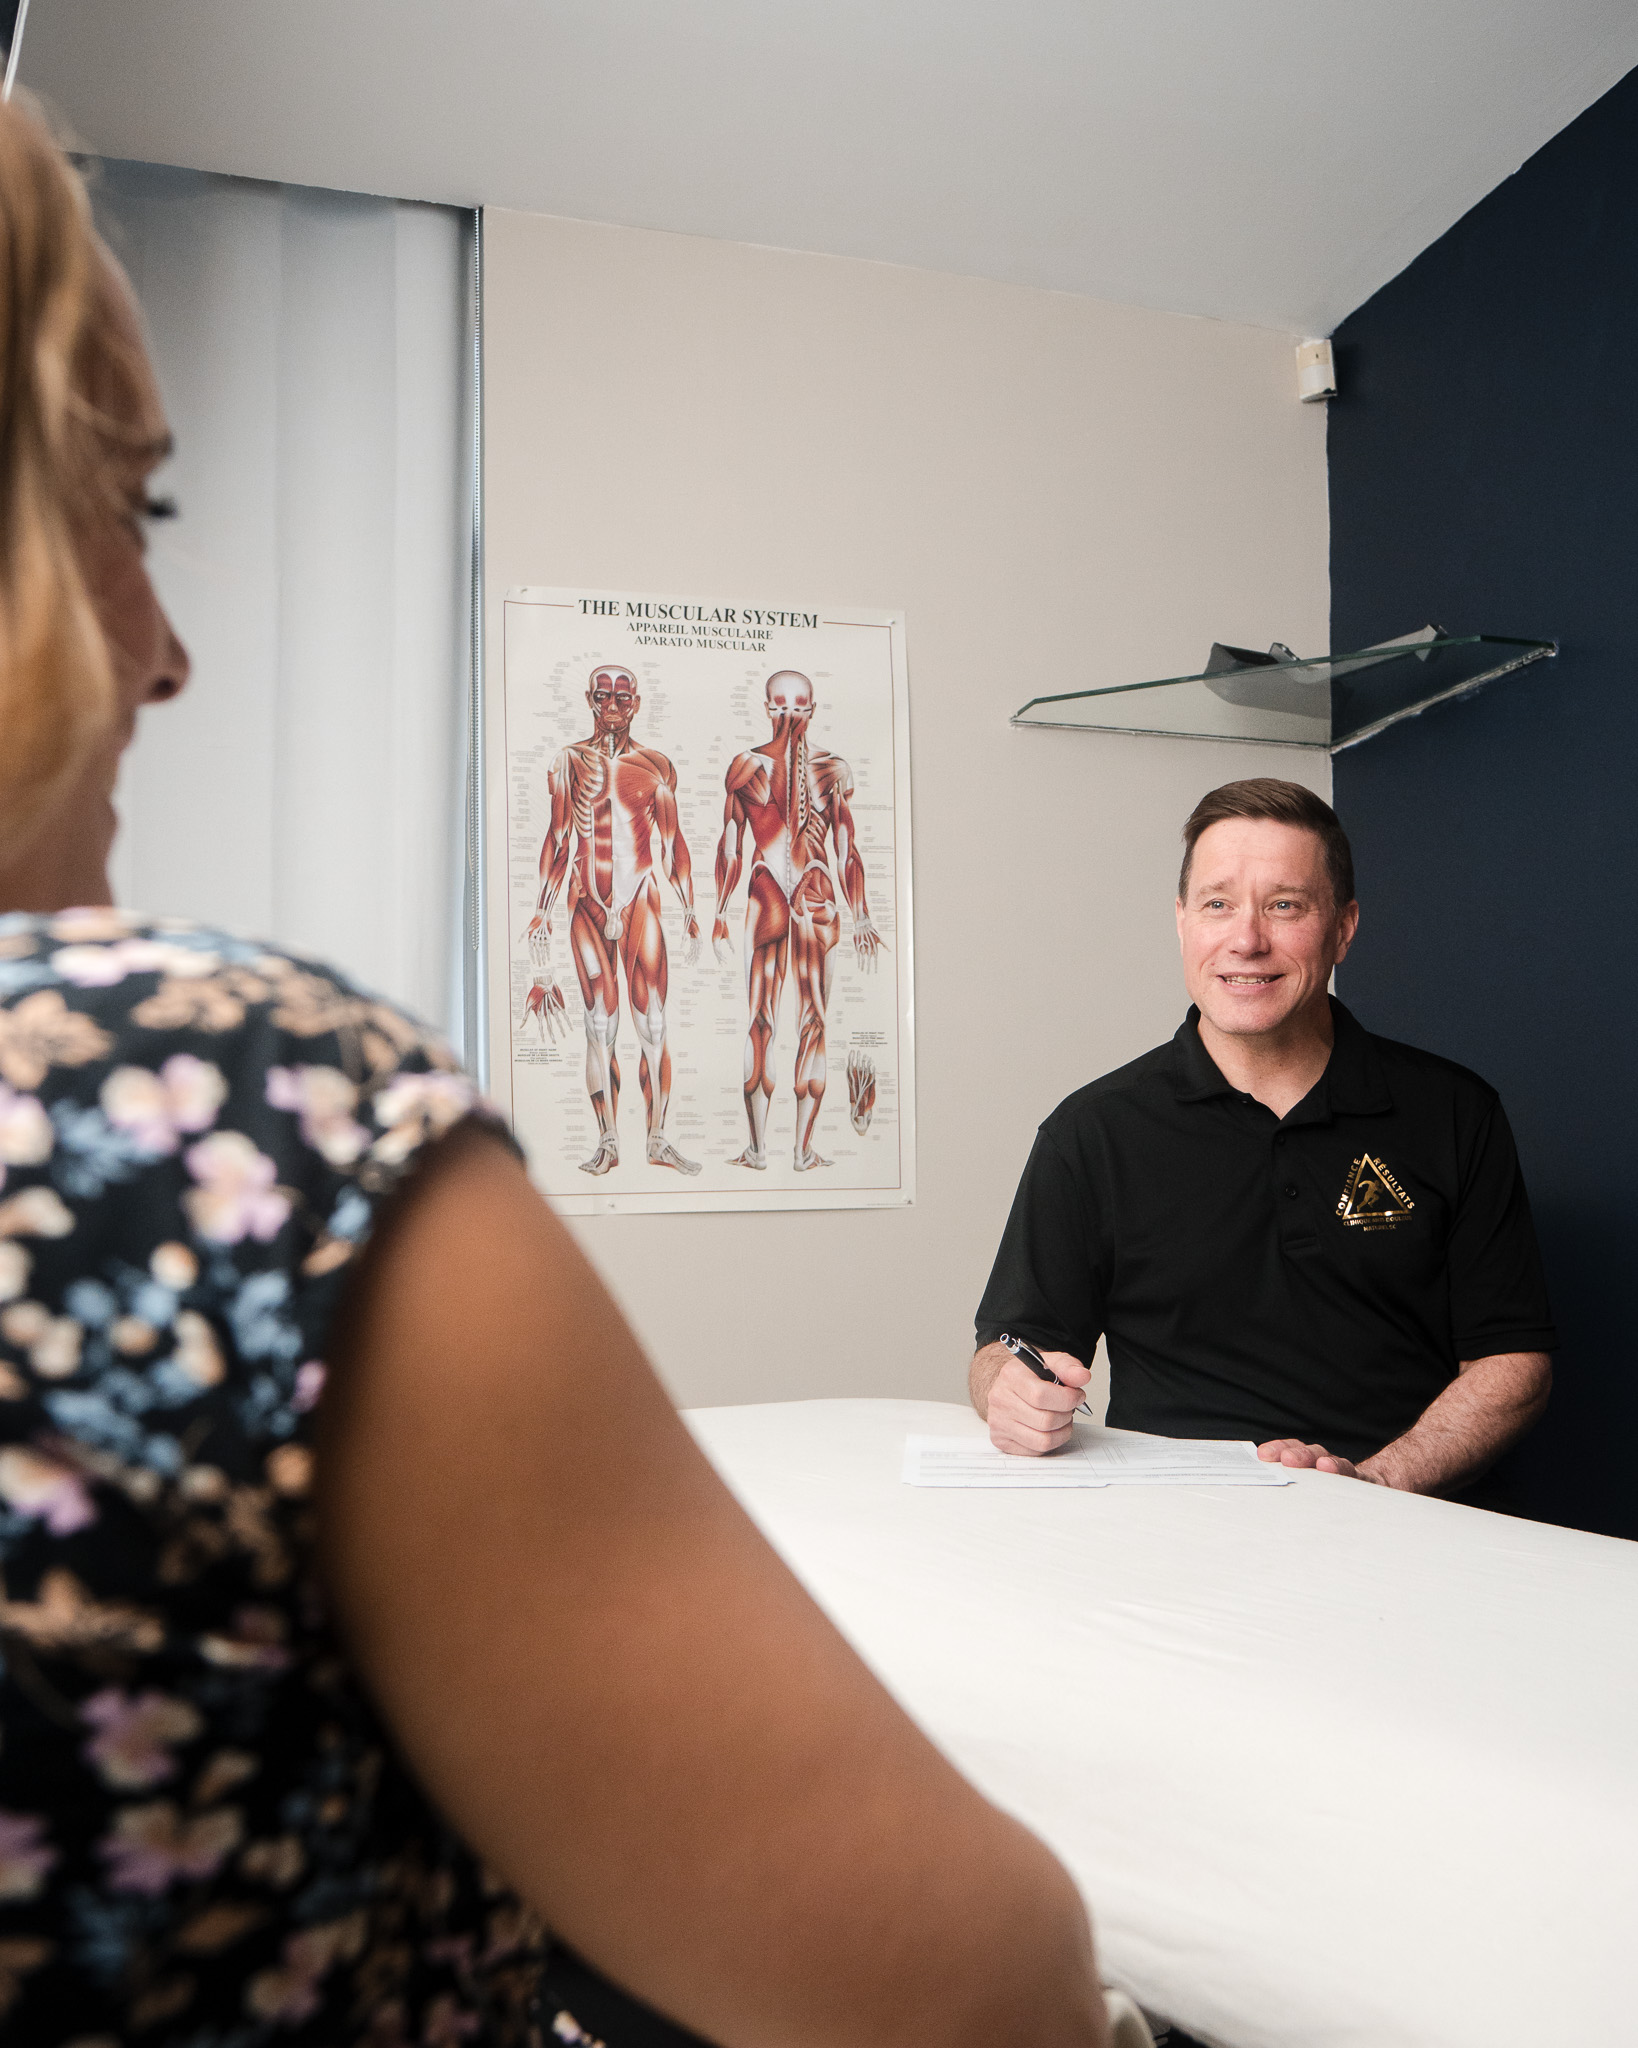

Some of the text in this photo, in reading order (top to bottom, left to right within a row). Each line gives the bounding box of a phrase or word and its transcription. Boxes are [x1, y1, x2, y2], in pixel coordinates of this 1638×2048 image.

[578, 599, 818, 629] THE MUSCULAR SYSTEM
[626, 622, 773, 640] APPAREIL MUSCULAIRE
[634, 635, 766, 652] APARATO MUSCULAR
[1335, 1158, 1361, 1216] CONFIANCE
[1373, 1157, 1415, 1210] RÉSULTATS
